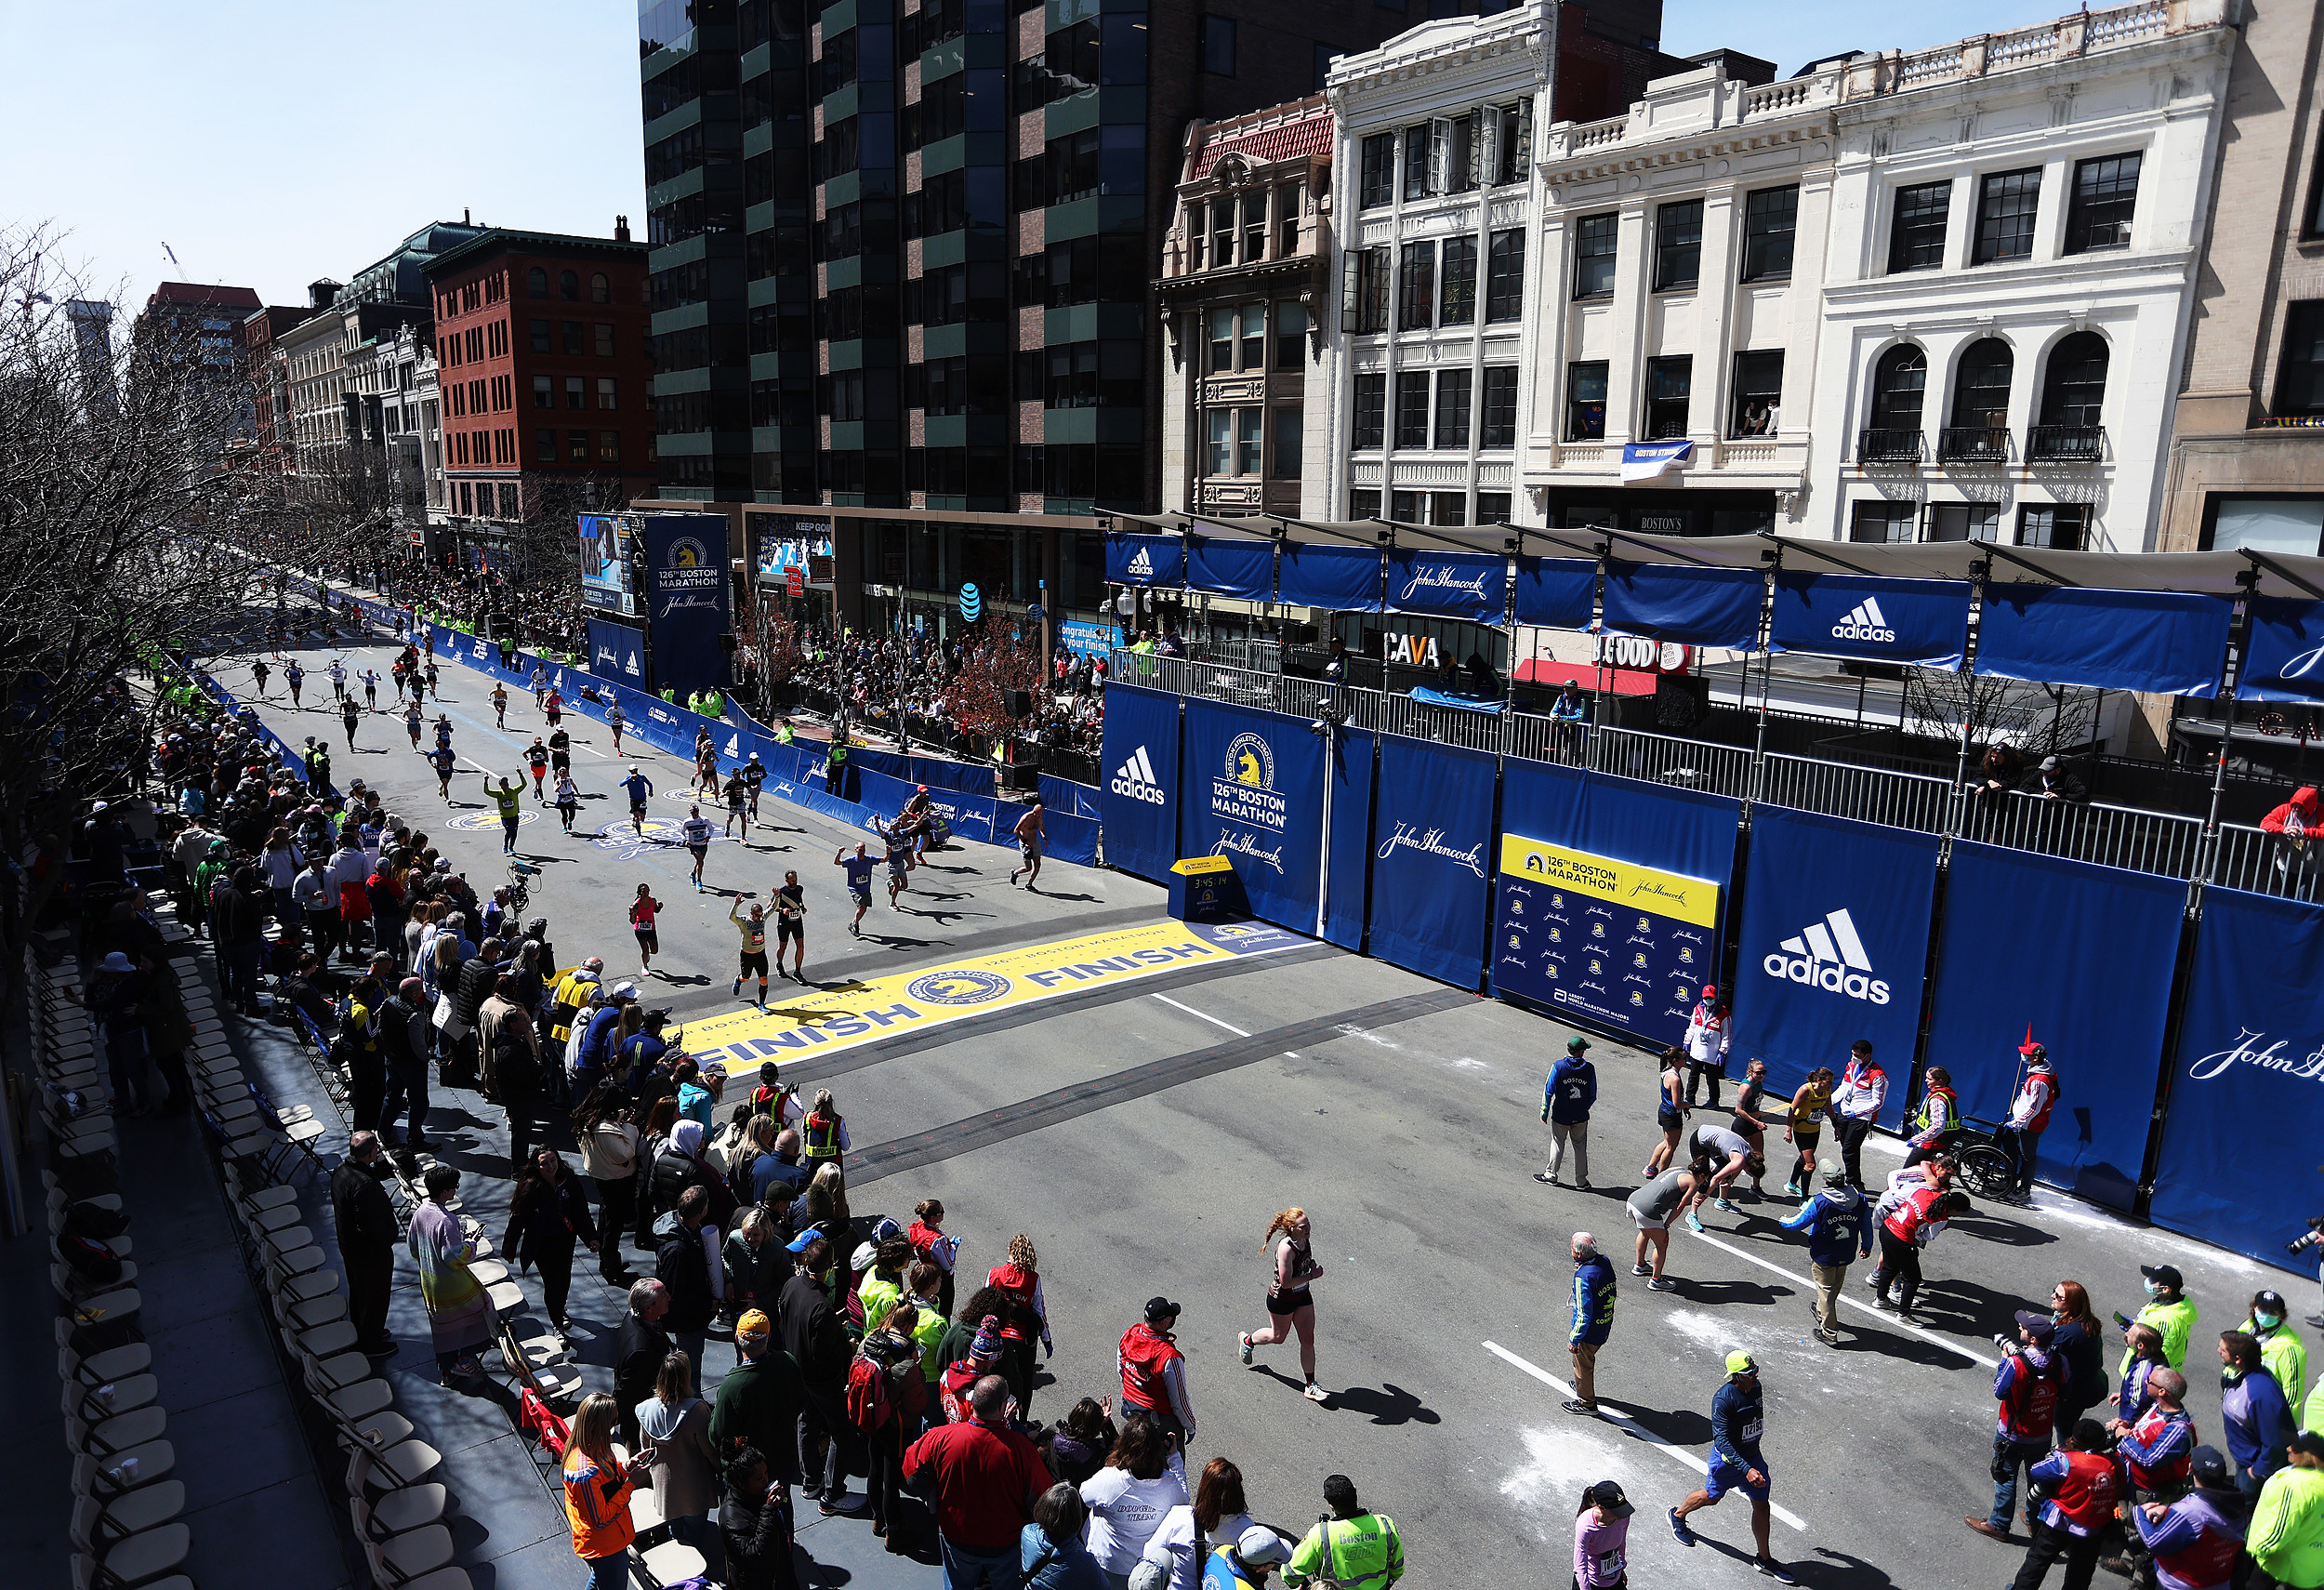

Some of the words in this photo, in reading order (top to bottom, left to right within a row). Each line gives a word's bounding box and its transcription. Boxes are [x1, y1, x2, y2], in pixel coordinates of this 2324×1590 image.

[1634, 449, 1657, 457] BOSTON
[796, 522, 814, 531] KEEP
[1641, 516, 1682, 531] BOSTON'S
[659, 570, 680, 579] 126TH
[680, 568, 718, 578] BOSTON
[1128, 564, 1154, 576] adidas
[659, 577, 718, 589] MARATHON
[865, 584, 884, 597] AT&T
[1401, 564, 1434, 600] John
[1433, 565, 1487, 601] Hancock
[659, 596, 683, 618] John
[682, 594, 720, 612] Hancock
[1831, 622, 1895, 643] adidas
[1067, 638, 1084, 649] your
[1085, 639, 1109, 652] finish.
[1383, 633, 1441, 668] CAVA
[625, 666, 640, 677] adidas
[1234, 735, 1257, 749] ATHLETIC
[724, 747, 739, 759] adidas
[1227, 747, 1235, 778] BOSTON
[1256, 738, 1273, 788] ASSOCIATION
[1111, 777, 1165, 805] adidas
[1212, 782, 1238, 798] 126TH
[1238, 788, 1285, 813] BOSTON
[1212, 797, 1285, 828] MARATHON
[1209, 828, 1240, 856] John
[1238, 833, 1285, 875] Hancock
[1378, 820, 1419, 859] John
[1418, 827, 1485, 878] Hancock
[1547, 855, 1571, 868] 126TH
[1572, 861, 1617, 881] BOSTON
[1195, 876, 1227, 889] 3:45:14
[1547, 867, 1616, 893] MARATHON
[1628, 879, 1653, 897] John
[1651, 882, 1688, 908] Hancock
[984, 957, 1021, 966] 126TH
[1025, 944, 1085, 958] BOSTON
[1089, 930, 1166, 946] MARATHON
[1023, 943, 1214, 988] FINISH
[925, 971, 999, 982] MARATHON
[1763, 953, 1891, 1005] adidas
[968, 983, 1008, 1003] RUNNING
[1567, 992, 1586, 1001] ABBOTT
[1567, 997, 1583, 1006] WORLD
[1583, 1002, 1610, 1014] MARATHON
[1610, 1011, 1630, 1021] MAJORS
[701, 1014, 766, 1032] BOSTO
[690, 1003, 922, 1072] FINISH
[2189, 1026, 2293, 1080] John
[1563, 1077, 1588, 1086] BOSTON
[1827, 1214, 1858, 1226] BOSTON
[2030, 1405, 2050, 1413] MEDIA
[1127, 1513, 1157, 1521] TEAM
[1338, 1531, 1379, 1546] Boston
[1344, 1544, 1377, 1561] EMS
